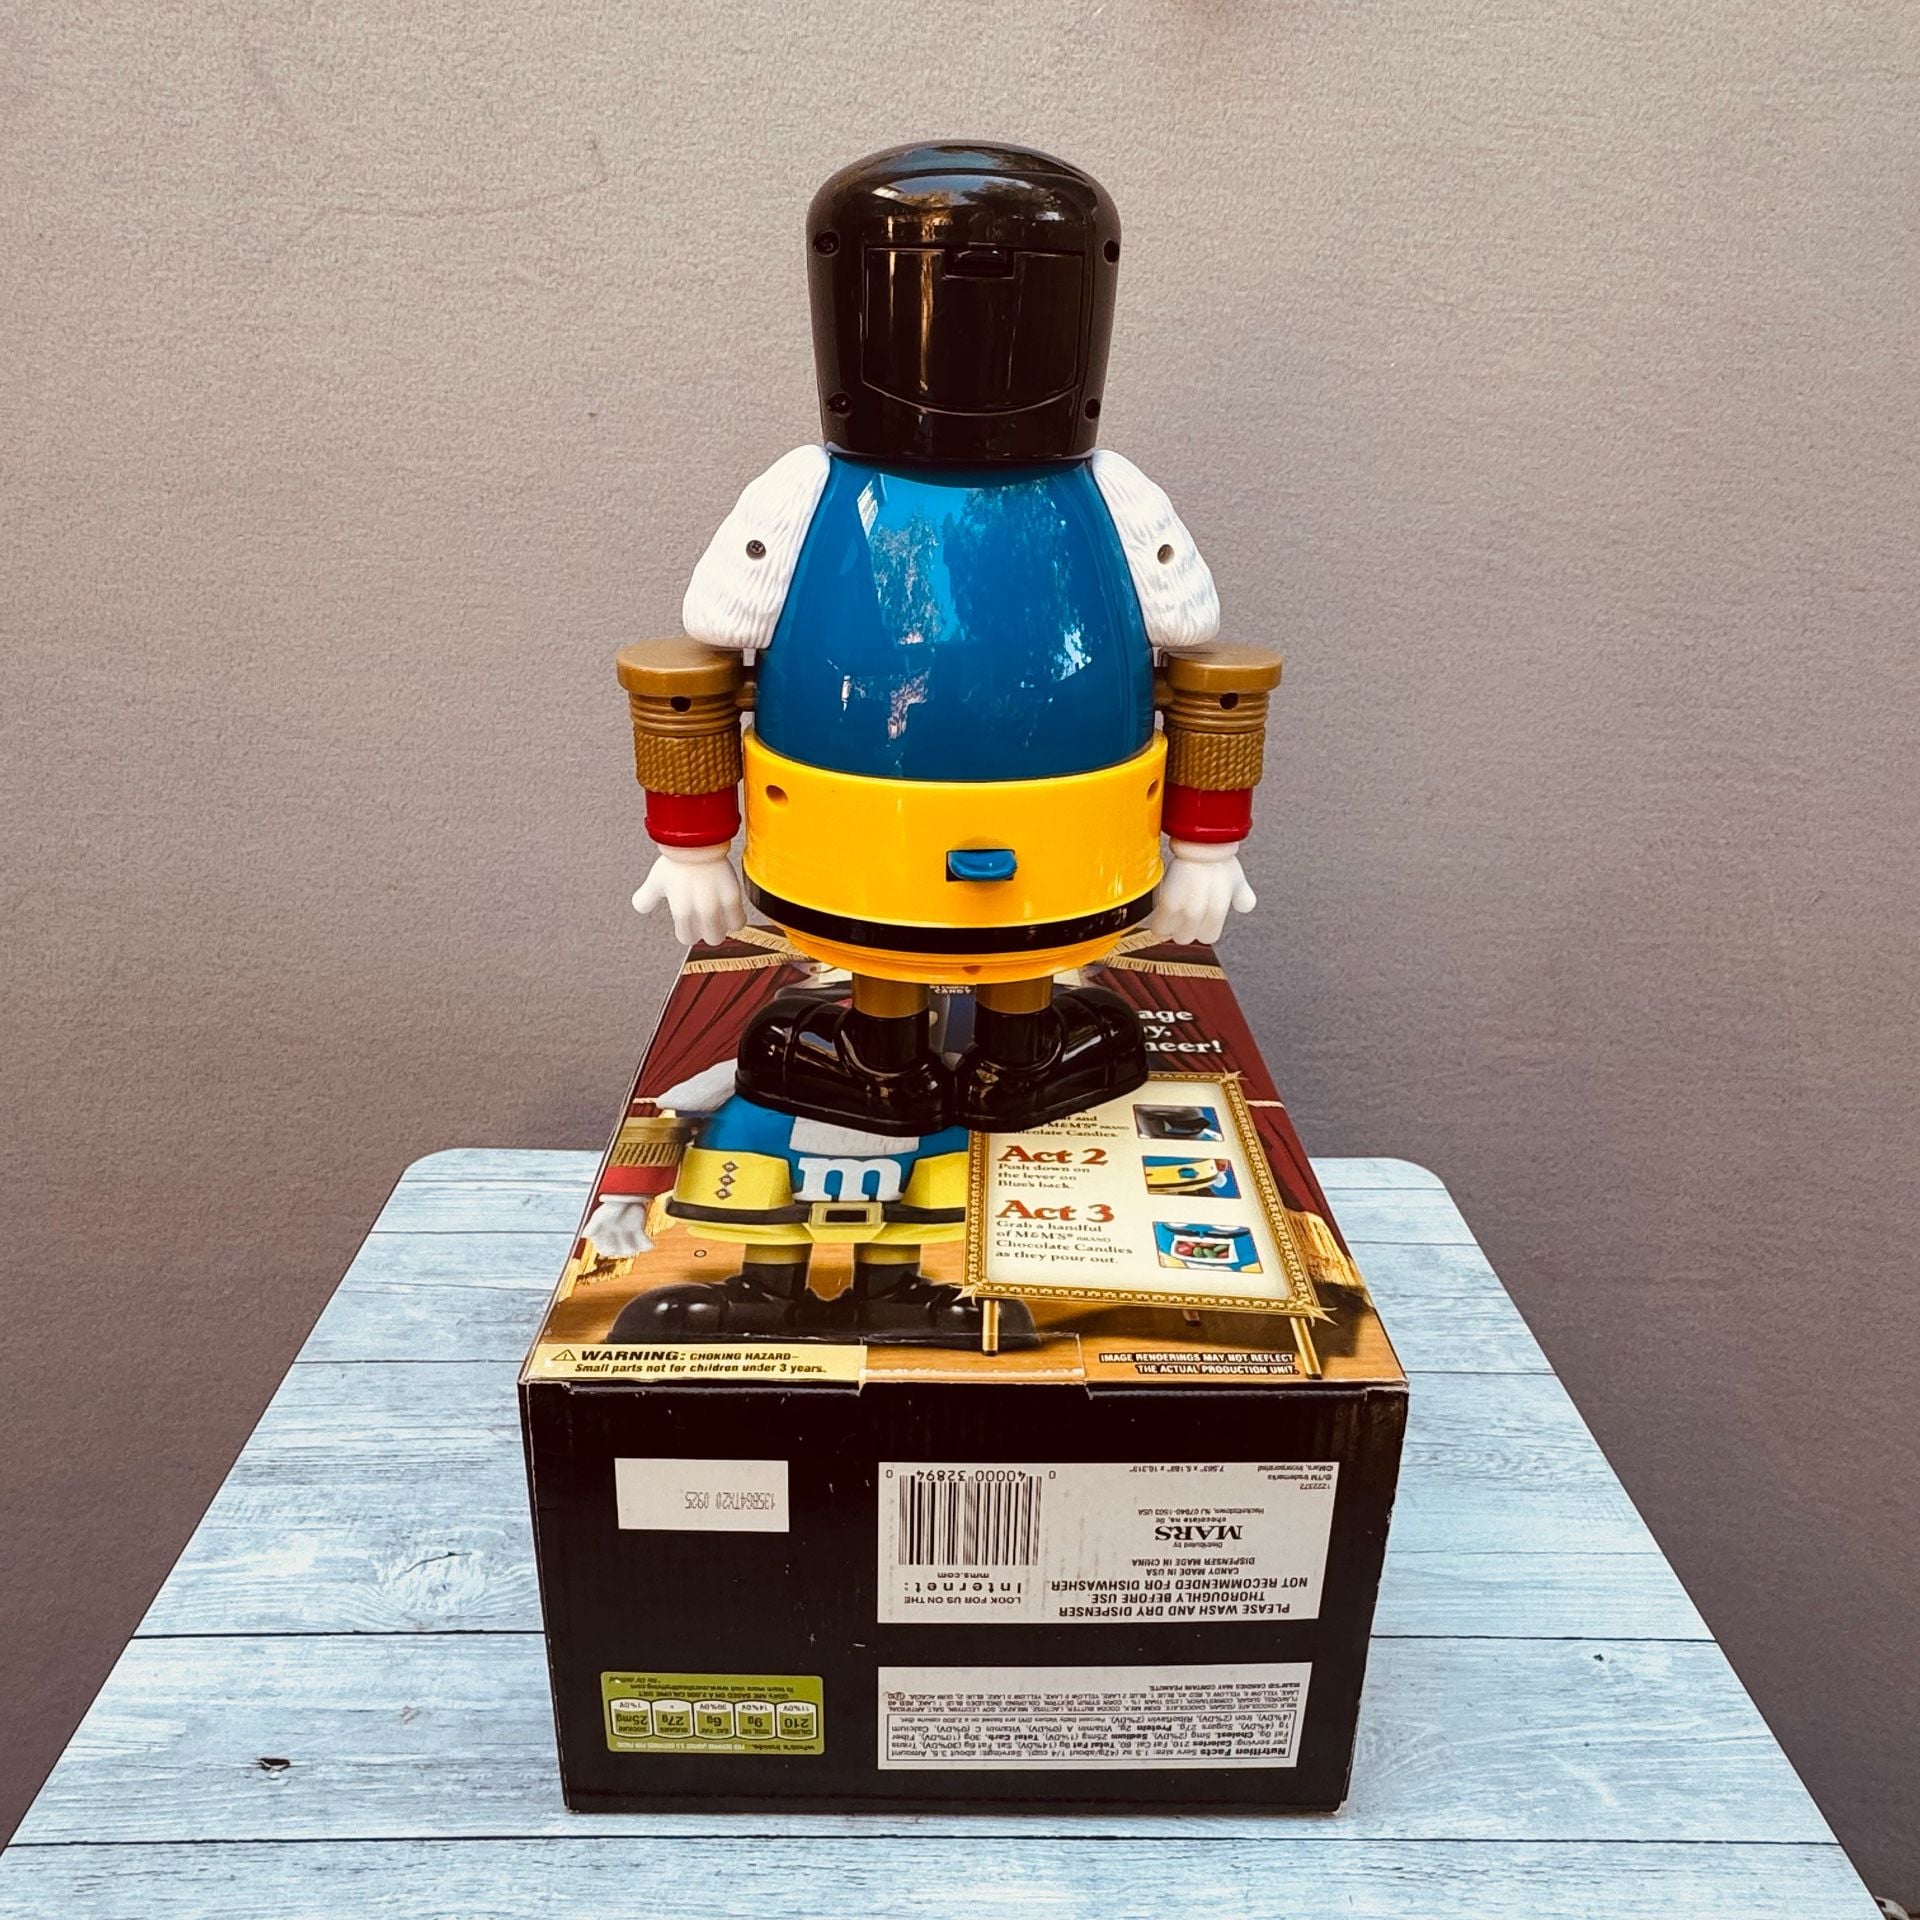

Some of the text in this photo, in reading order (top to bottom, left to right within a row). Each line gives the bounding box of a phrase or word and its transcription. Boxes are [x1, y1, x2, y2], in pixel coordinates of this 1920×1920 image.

[1138, 1010, 1194, 1023] age
[997, 1145, 1109, 1166] Act 2
[998, 1163, 1030, 1171] Push
[1033, 1164, 1070, 1173] down
[797, 1157, 903, 1202] m
[1023, 1172, 1057, 1181] lever
[998, 1180, 1074, 1190] Blue's back.
[995, 1200, 1115, 1223] Act 3
[996, 1220, 1032, 1229] Grab
[1048, 1222, 1102, 1232] handful
[996, 1239, 1133, 1254] Chocolate Candies
[1014, 1251, 1047, 1261] they
[1051, 1254, 1087, 1262] pour
[581, 1351, 686, 1361] WARNING:
[690, 1353, 742, 1361] CHOKING
[1100, 1353, 1294, 1362] IMAGE RENDERINGS MAY NOT REFLECT
[575, 1363, 827, 1375] Small parts not for children under 3 years.
[1137, 1365, 1299, 1375] THE ACTUAL PRODUCTION UNIT.
[886, 1469, 1056, 1482] 0 40000 32894 0
[1154, 1525, 1243, 1541] MARS
[1184, 1541, 1223, 1549] Distributed
[1131, 1557, 1255, 1567] DISPENSER MADE IN CHINA
[1146, 1567, 1239, 1576] CANDY MADE IN USA
[903, 1582, 1022, 1594] Internet:
[1144, 1580, 1170, 1591] FOR
[1175, 1578, 1278, 1590] RECOMMENDED
[1281, 1578, 1308, 1588] NOT
[904, 1596, 1021, 1605] LOOK FOR US ON THE
[1121, 1593, 1172, 1603] BEFORE
[1176, 1591, 1265, 1602] THOROUGHLY
[1059, 1604, 1290, 1617] PLEASE WASH AND DRY DISPENSER
[616, 1713, 648, 1725] 25mg
[662, 1714, 684, 1725] 27g
[707, 1714, 722, 1726] 6g
[747, 1716, 763, 1727] 9g
[784, 1718, 809, 1728] 210
[1137, 1724, 1172, 1732] Protein
[1111, 1733, 1148, 1741] Sodium
[1200, 1748, 1231, 1756] Facts
[1236, 1748, 1286, 1756] Nutrition
